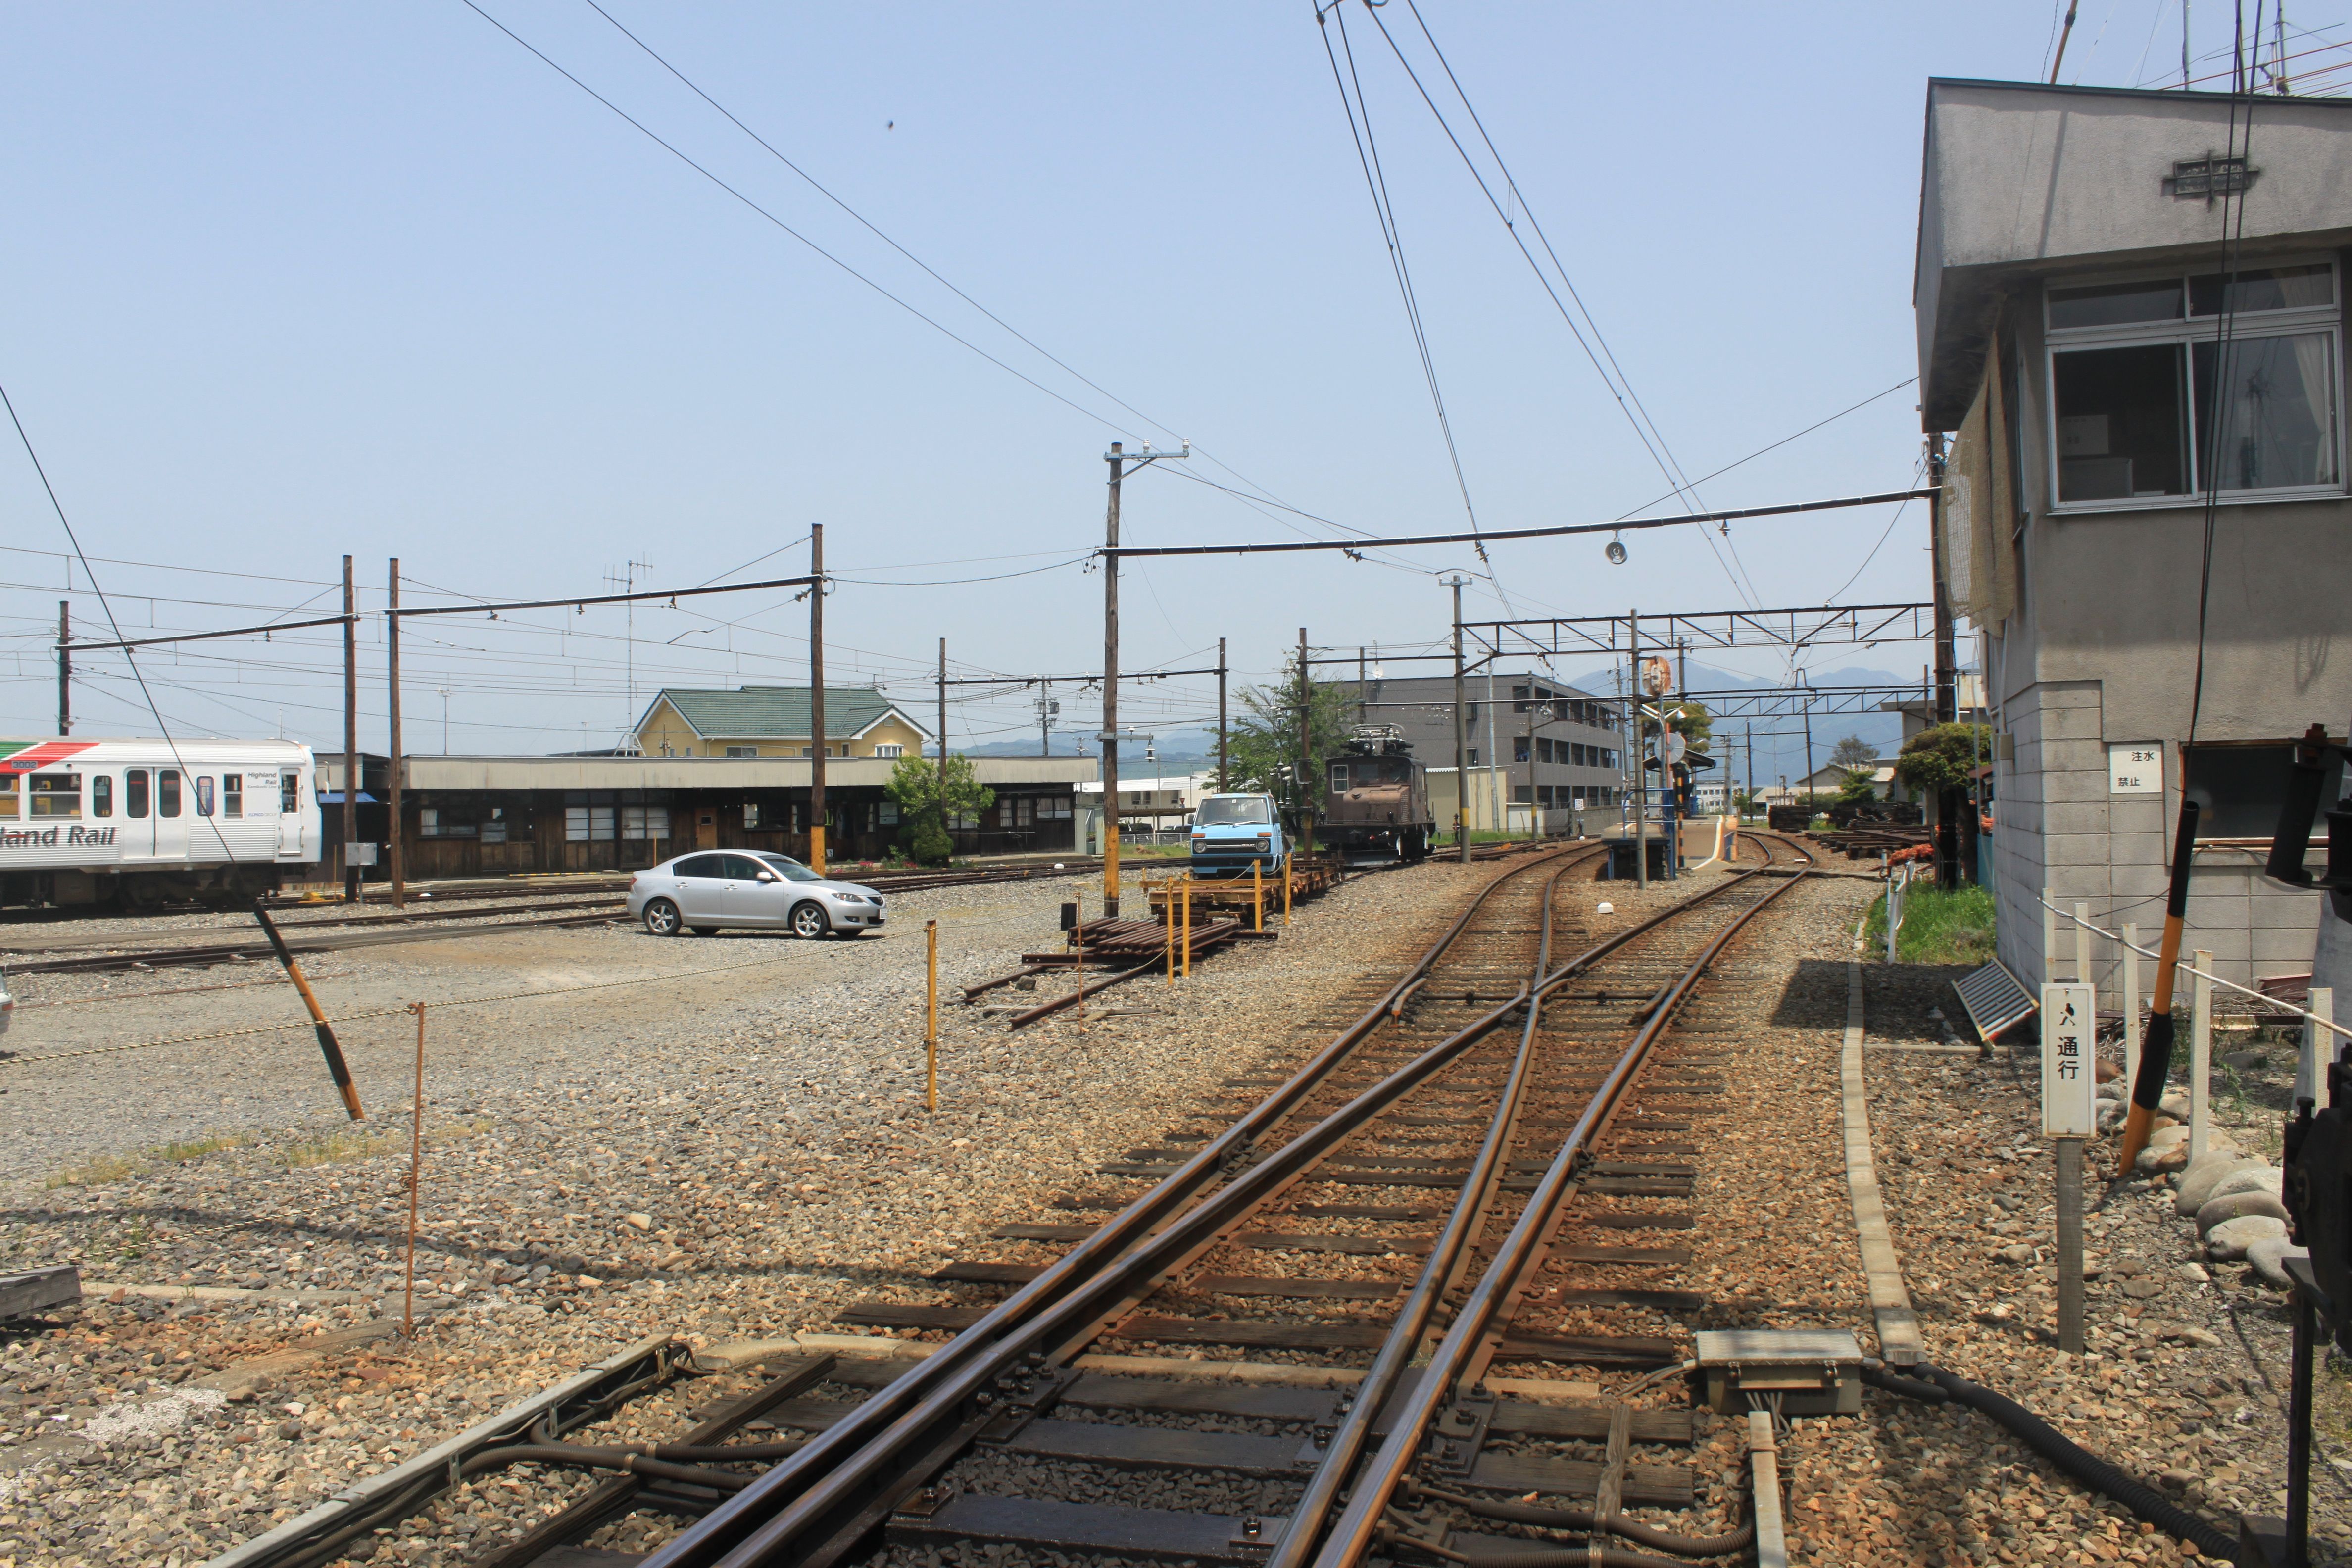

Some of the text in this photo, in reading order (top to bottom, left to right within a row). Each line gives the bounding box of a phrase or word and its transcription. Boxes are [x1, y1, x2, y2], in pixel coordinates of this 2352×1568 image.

[2131, 751, 2154, 762] 注水
[2117, 777, 2141, 787] 禁止
[68, 825, 115, 846] Rail
[2057, 1036, 2079, 1080] 通行
